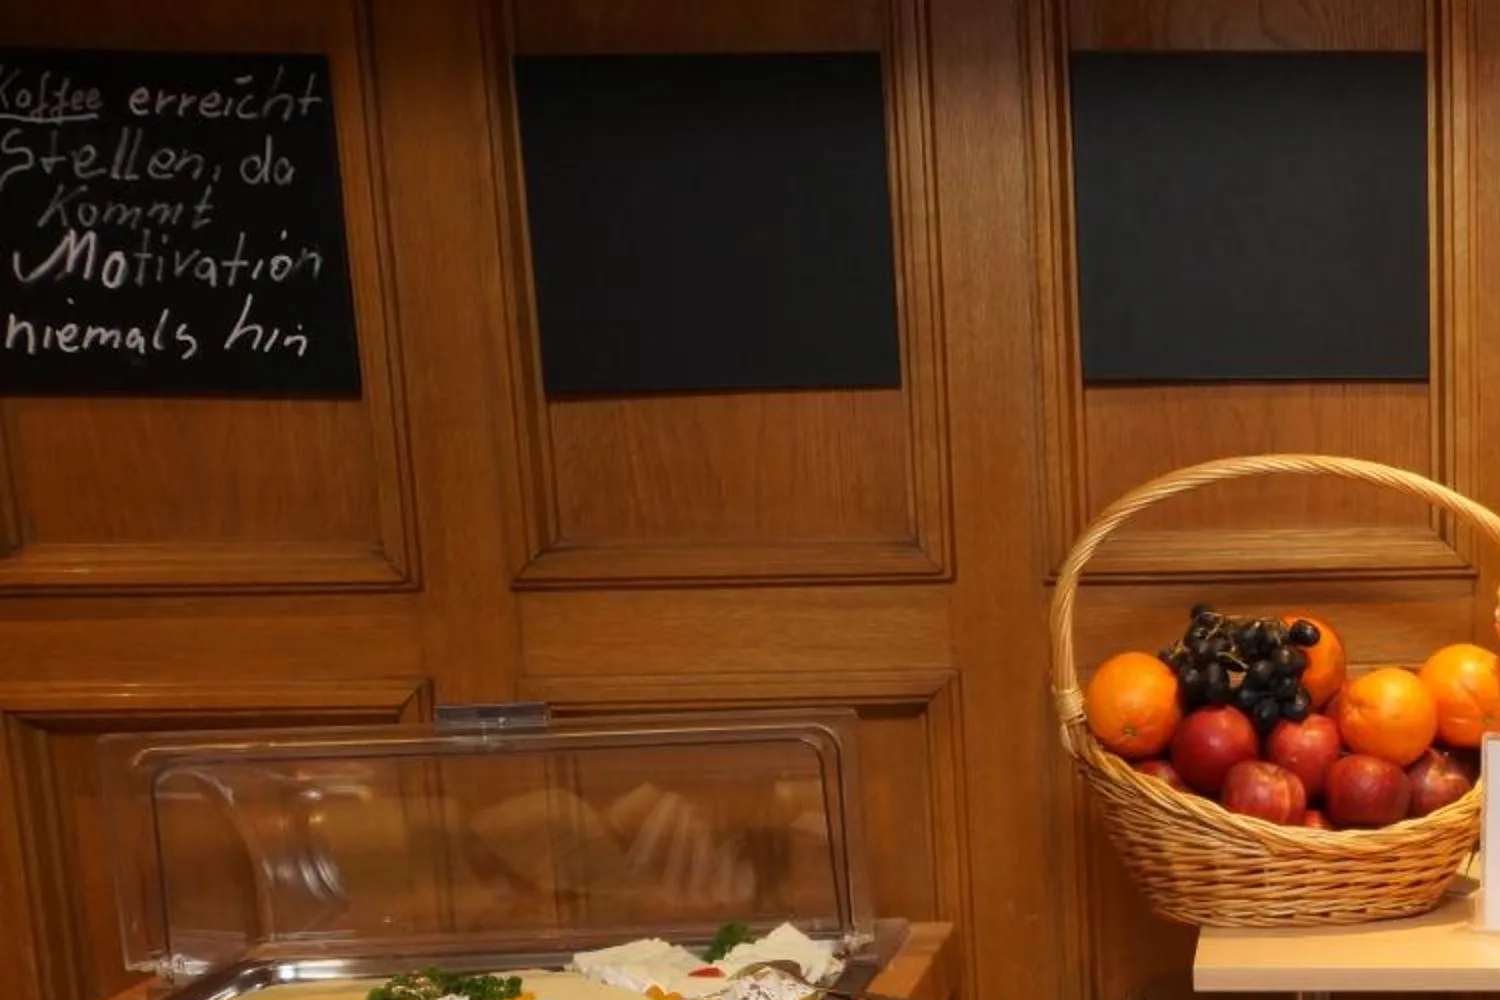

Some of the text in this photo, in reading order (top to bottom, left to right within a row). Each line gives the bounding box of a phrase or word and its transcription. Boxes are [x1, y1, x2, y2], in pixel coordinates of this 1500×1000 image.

[128, 64, 323, 121] erreicht
[239, 133, 296, 185] da
[12, 228, 323, 289] Motivation
[4, 293, 308, 360] niemals hin
